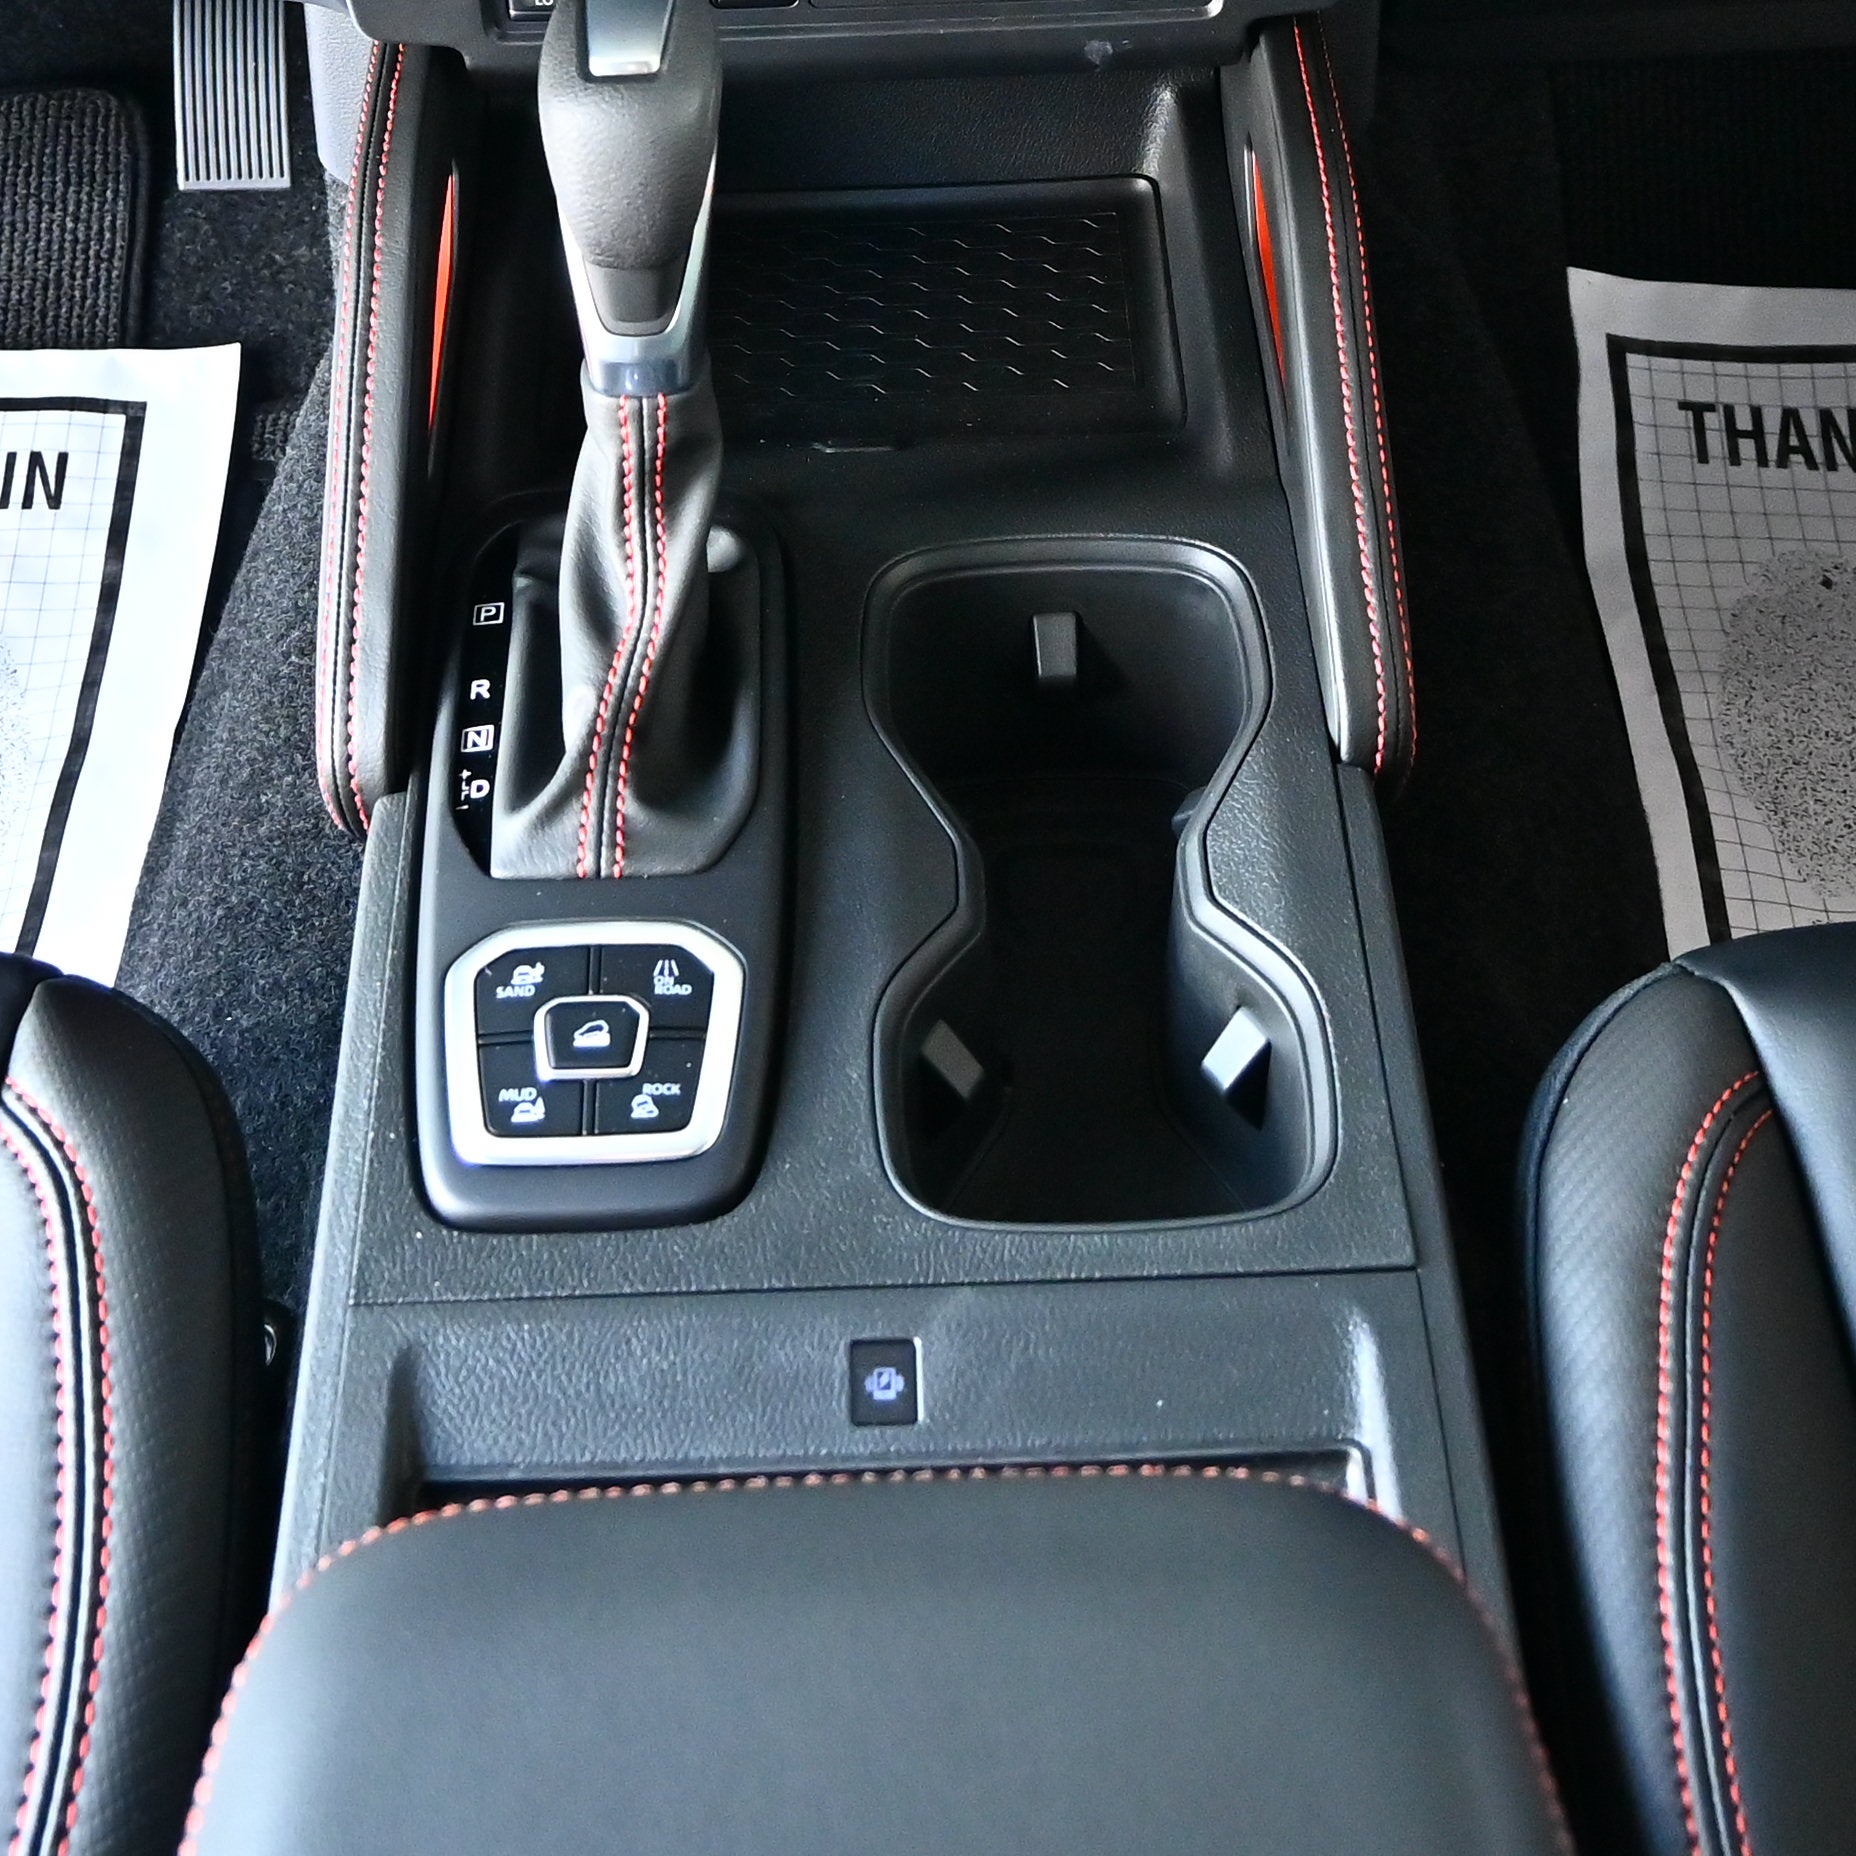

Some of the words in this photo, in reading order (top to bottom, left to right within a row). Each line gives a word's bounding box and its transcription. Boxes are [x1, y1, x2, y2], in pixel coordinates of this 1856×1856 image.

[470, 679, 491, 700] R
[496, 985, 536, 999] SAND
[654, 983, 693, 996] ROAD
[498, 1087, 537, 1103] MUD
[642, 1082, 682, 1096] ROCK
